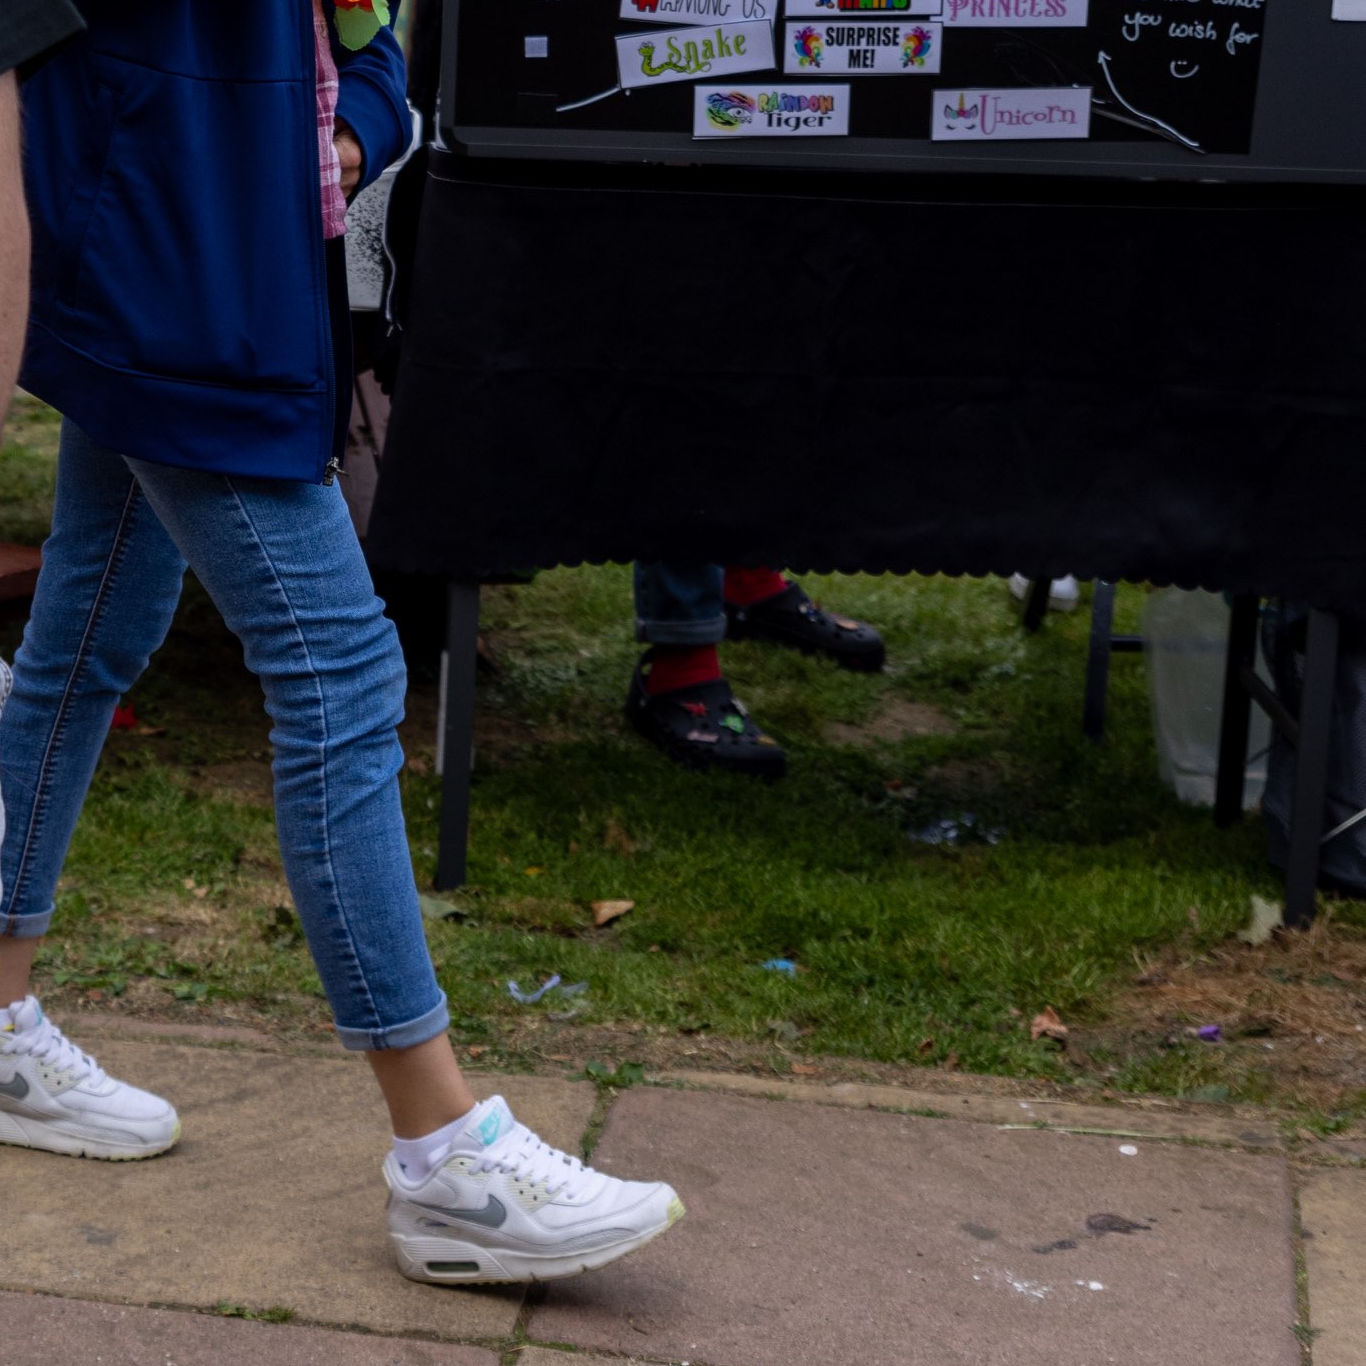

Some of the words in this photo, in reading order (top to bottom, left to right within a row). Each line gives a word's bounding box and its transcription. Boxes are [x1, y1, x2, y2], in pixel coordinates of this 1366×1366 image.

[824, 26, 900, 47] SURPRISE
[1122, 12, 1162, 42] you
[1168, 20, 1217, 40] wish
[1226, 22, 1259, 55] for
[665, 27, 747, 74] Snake
[847, 49, 875, 69] ME!
[764, 112, 832, 132] Tiger
[979, 93, 1077, 135] Unicorn
